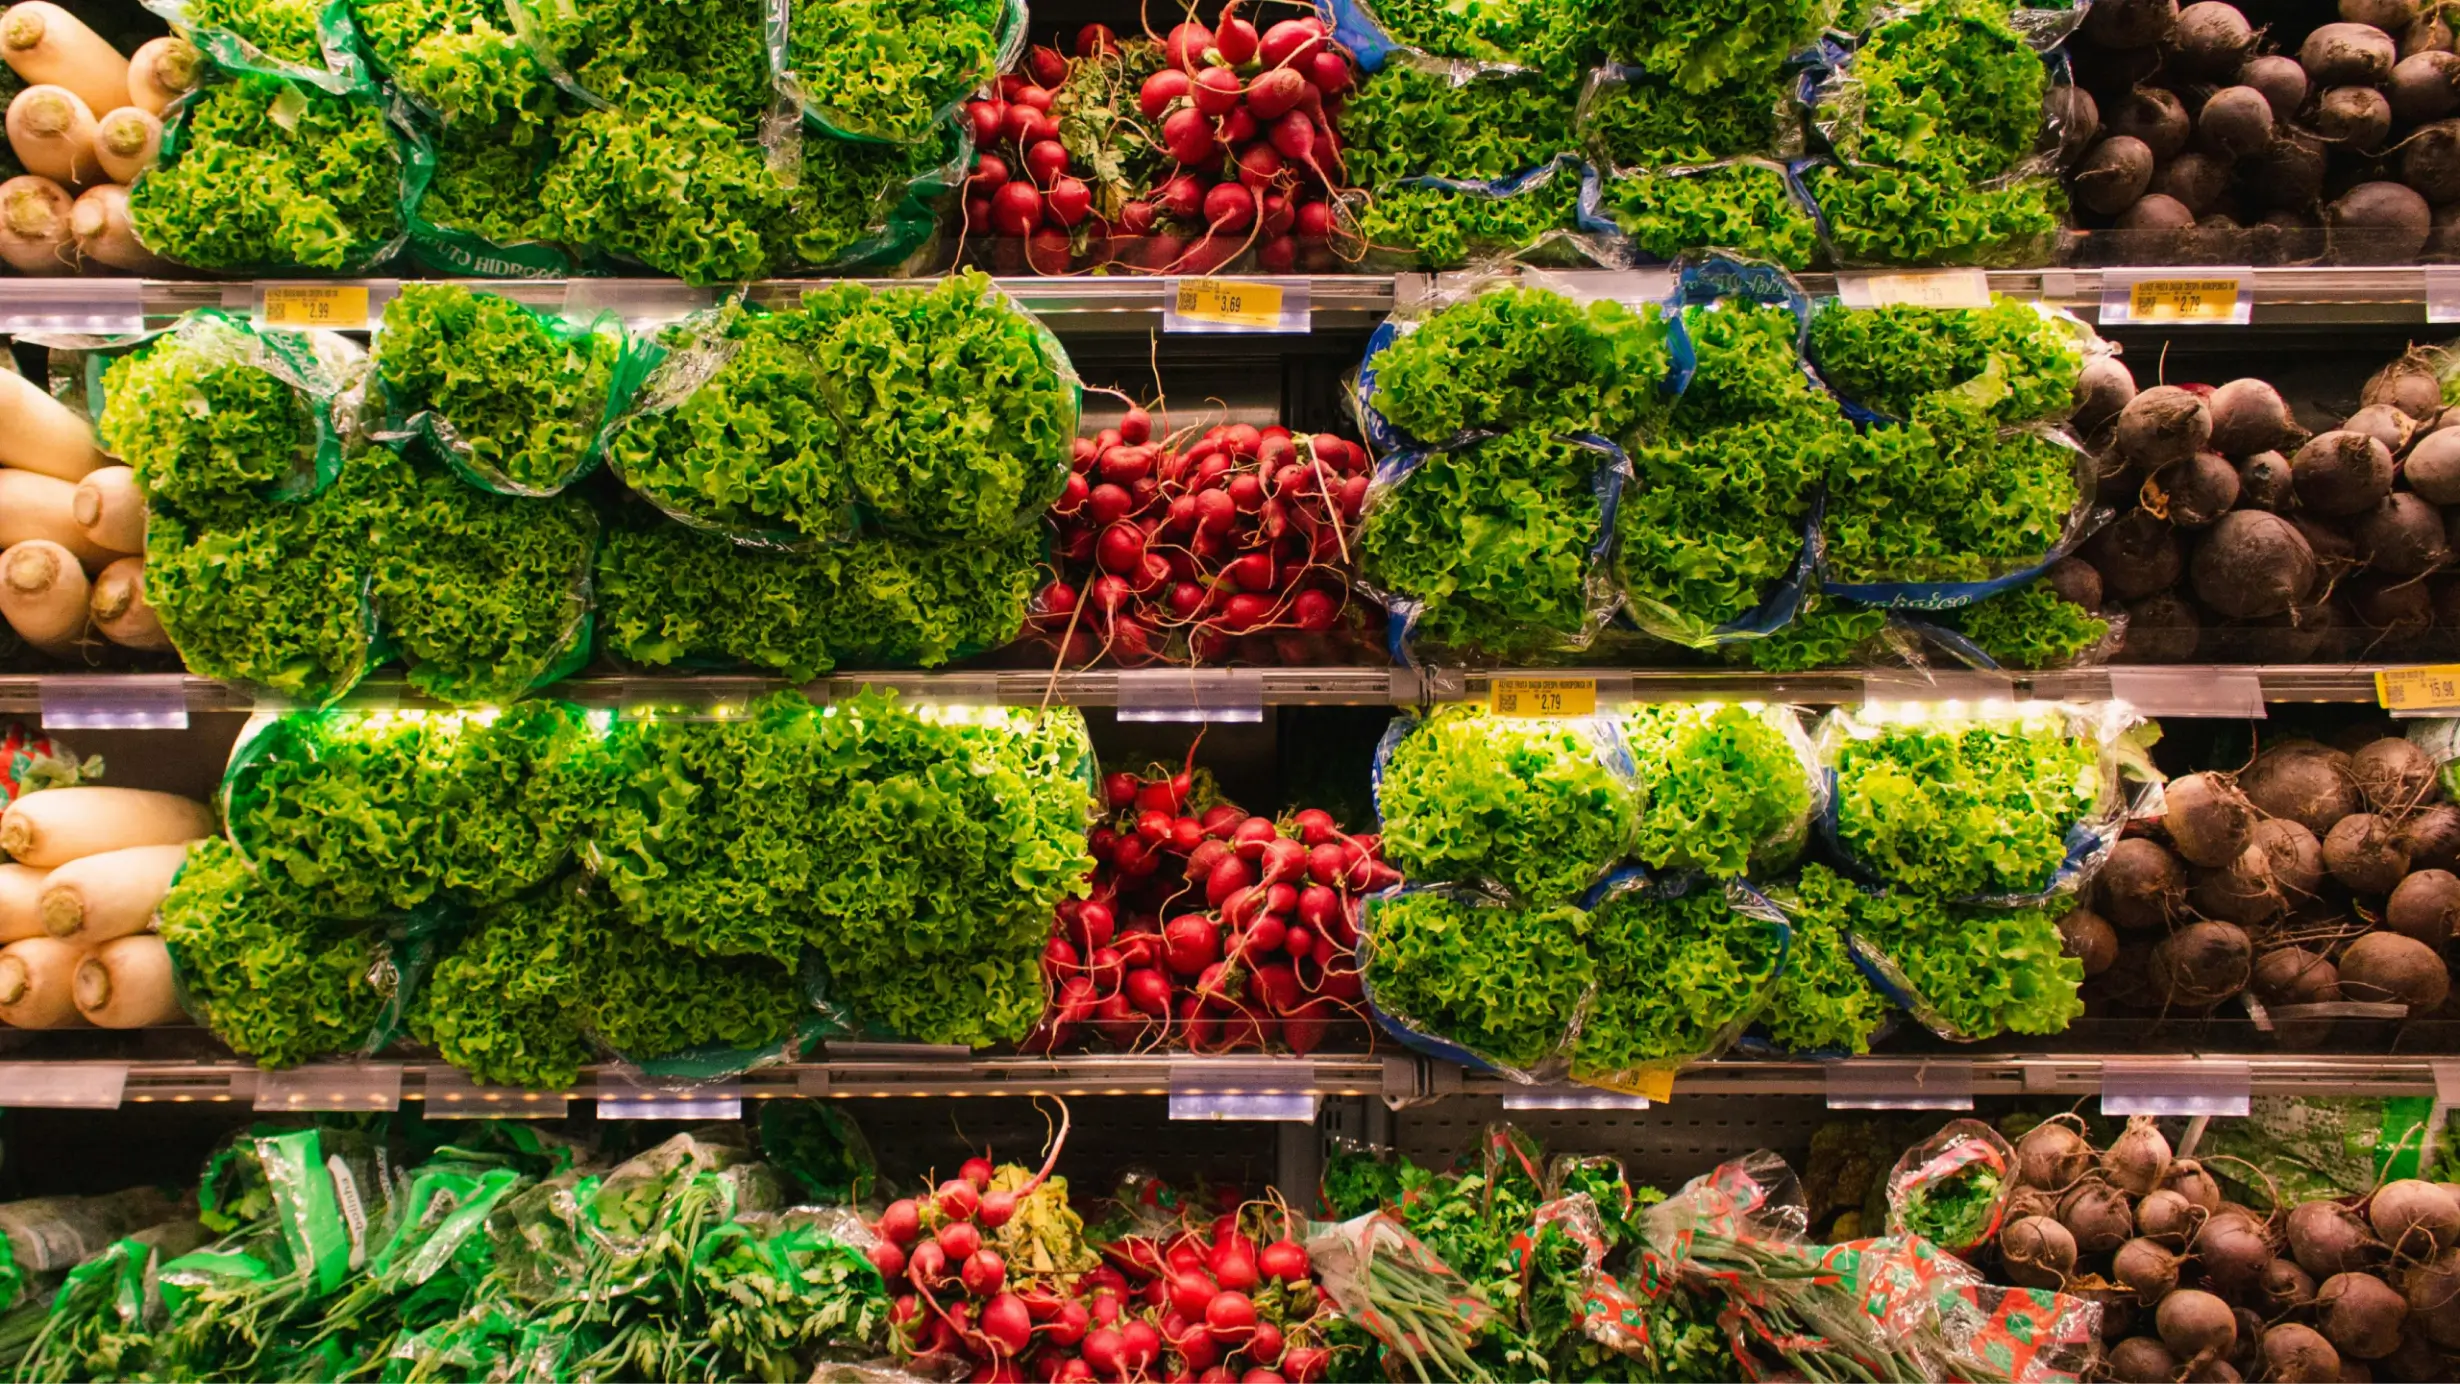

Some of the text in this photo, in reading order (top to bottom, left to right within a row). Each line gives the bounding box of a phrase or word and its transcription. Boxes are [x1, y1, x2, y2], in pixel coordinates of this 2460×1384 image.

[1922, 287, 1943, 301] 279
[1220, 295, 1241, 313] 3,69
[2180, 295, 2200, 313] 2,79
[1541, 693, 1561, 711] 2,79
